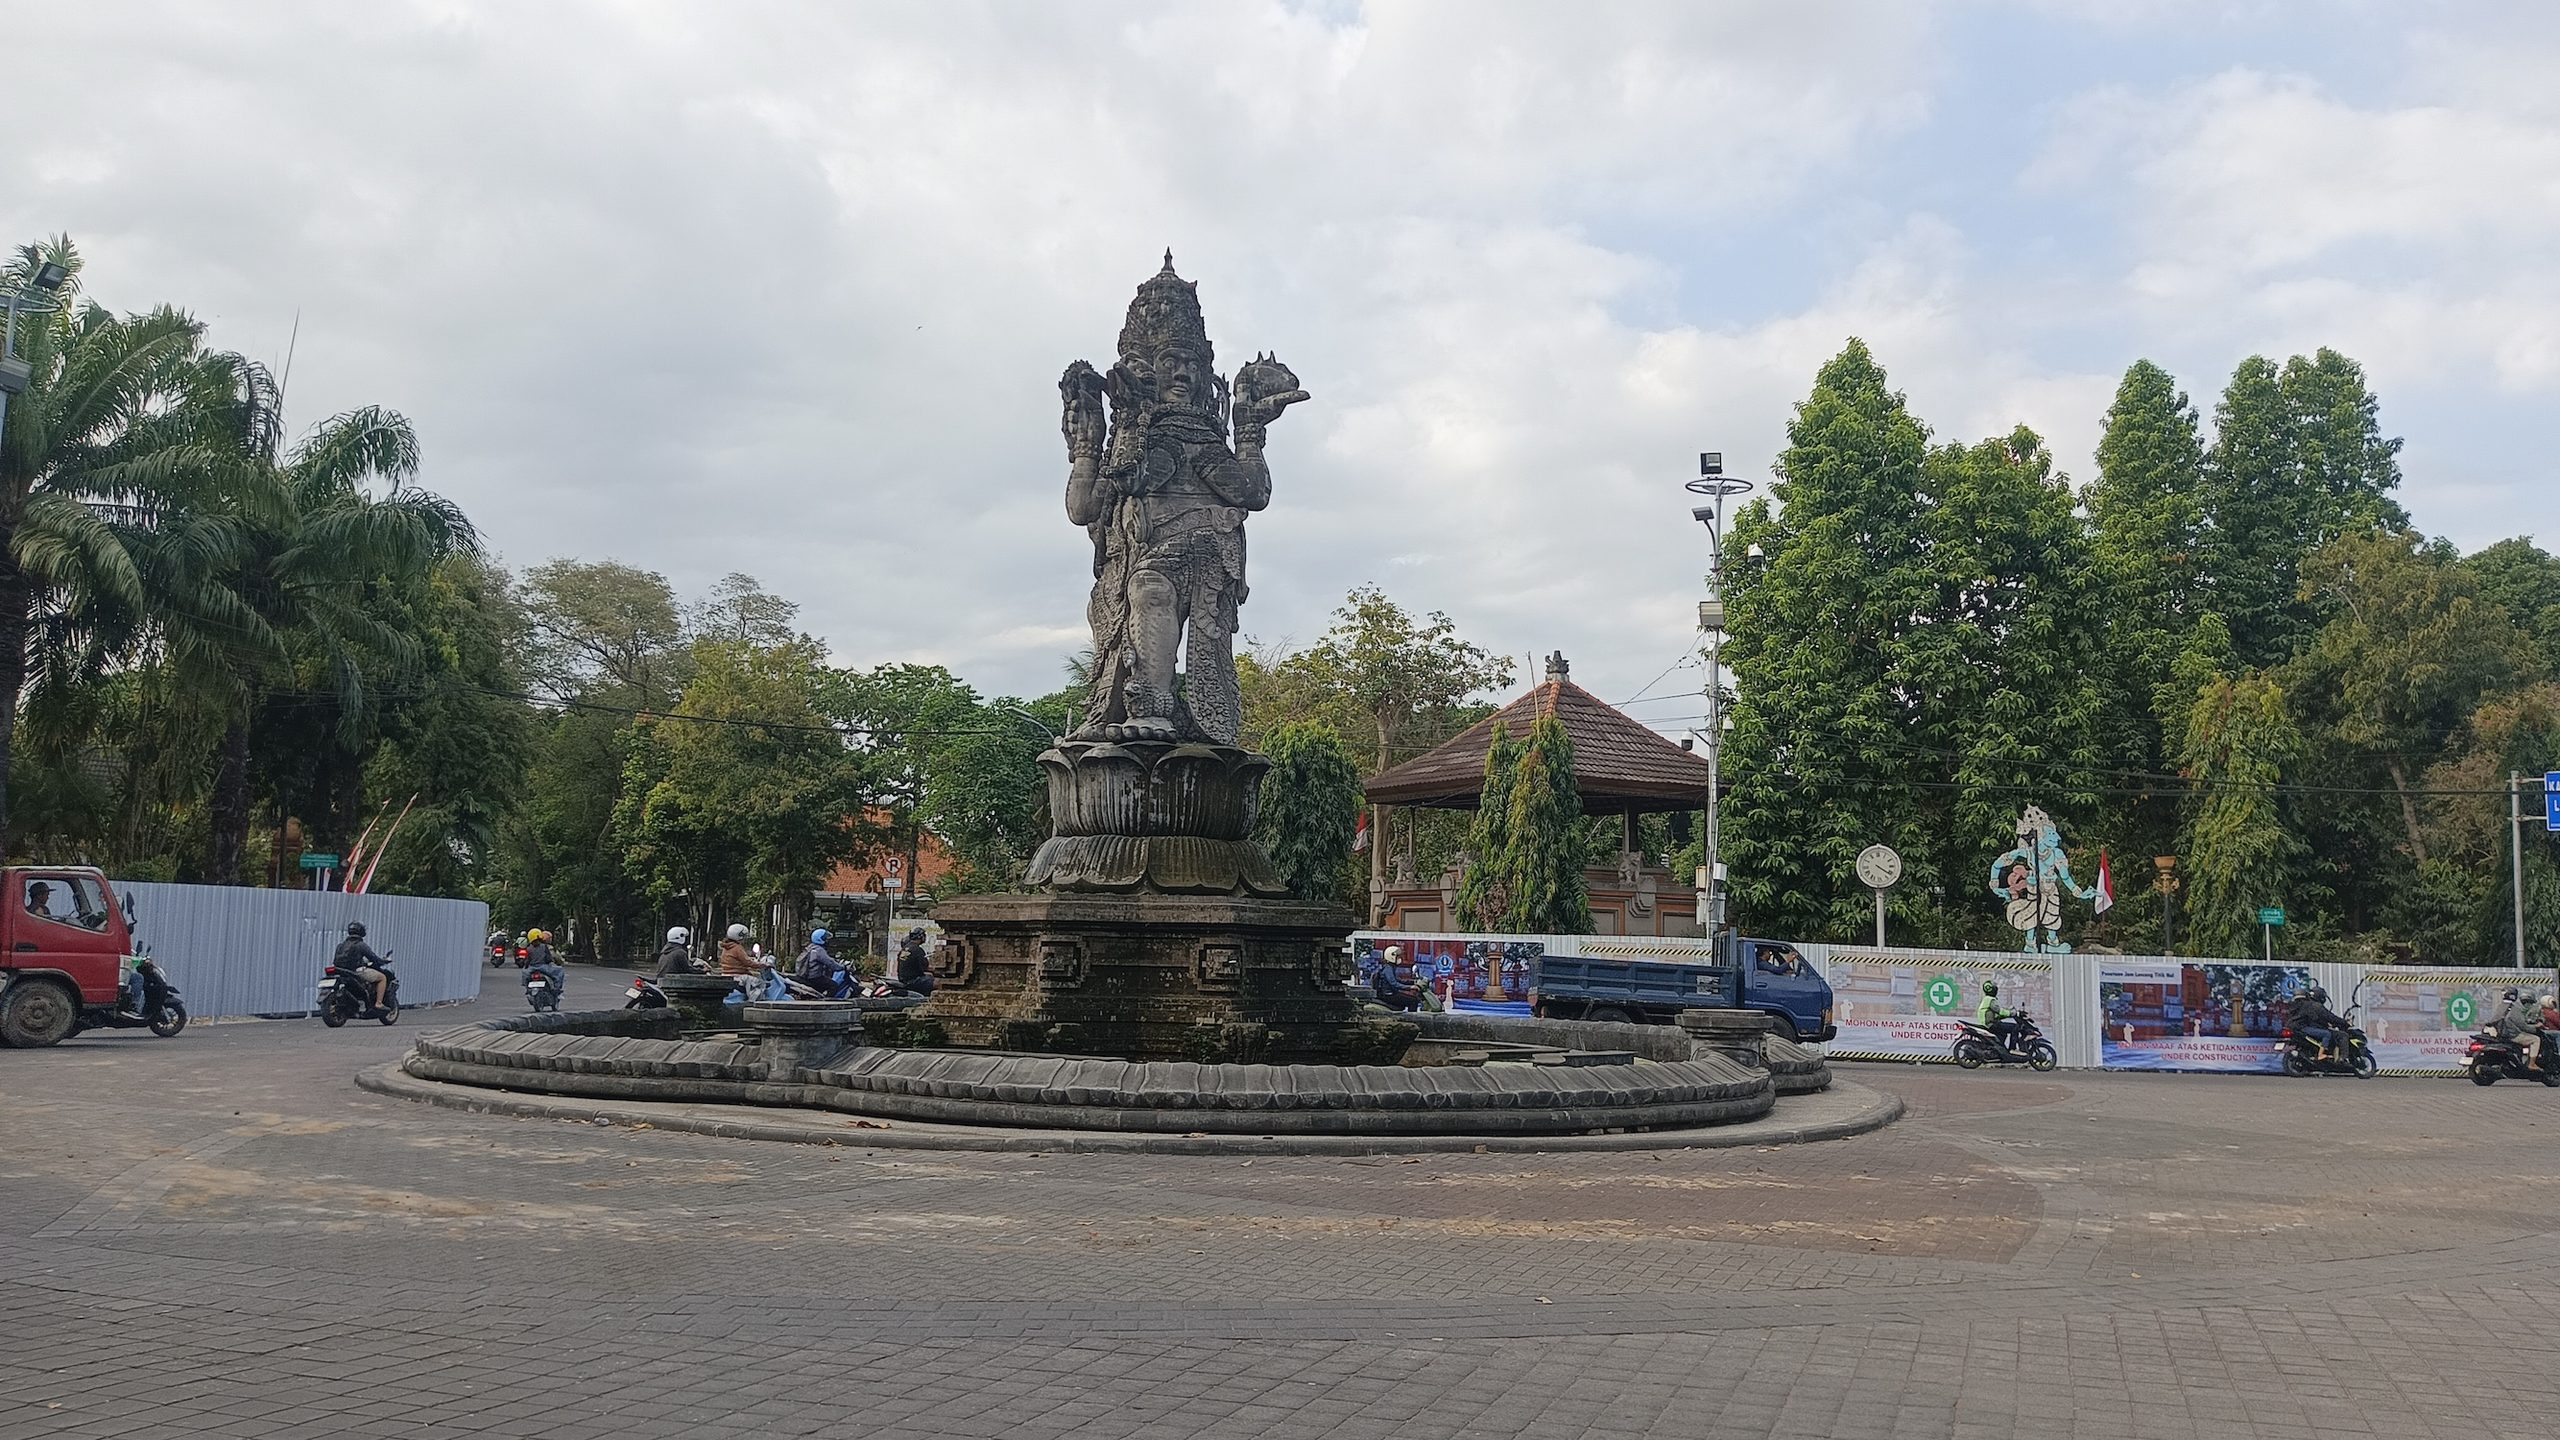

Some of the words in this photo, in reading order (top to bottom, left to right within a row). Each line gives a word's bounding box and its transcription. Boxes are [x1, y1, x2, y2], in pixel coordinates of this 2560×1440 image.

[1845, 1019, 1878, 1027] MOHON
[1881, 1020, 1906, 1029] MAAF
[1908, 1021, 1930, 1030] ATAS
[1891, 1031, 1922, 1039] UNDER
[2151, 1041, 2175, 1050] MAAF
[2177, 1042, 2198, 1051] ATAS
[2382, 1037, 2410, 1045] MOHON
[2412, 1037, 2432, 1046] MAAF
[2434, 1038, 2453, 1046] ATAS
[2420, 1047, 2446, 1055] UNDER
[2161, 1052, 2190, 1061] UNDER
[2192, 1053, 2257, 1062] CONSTRUCTION
